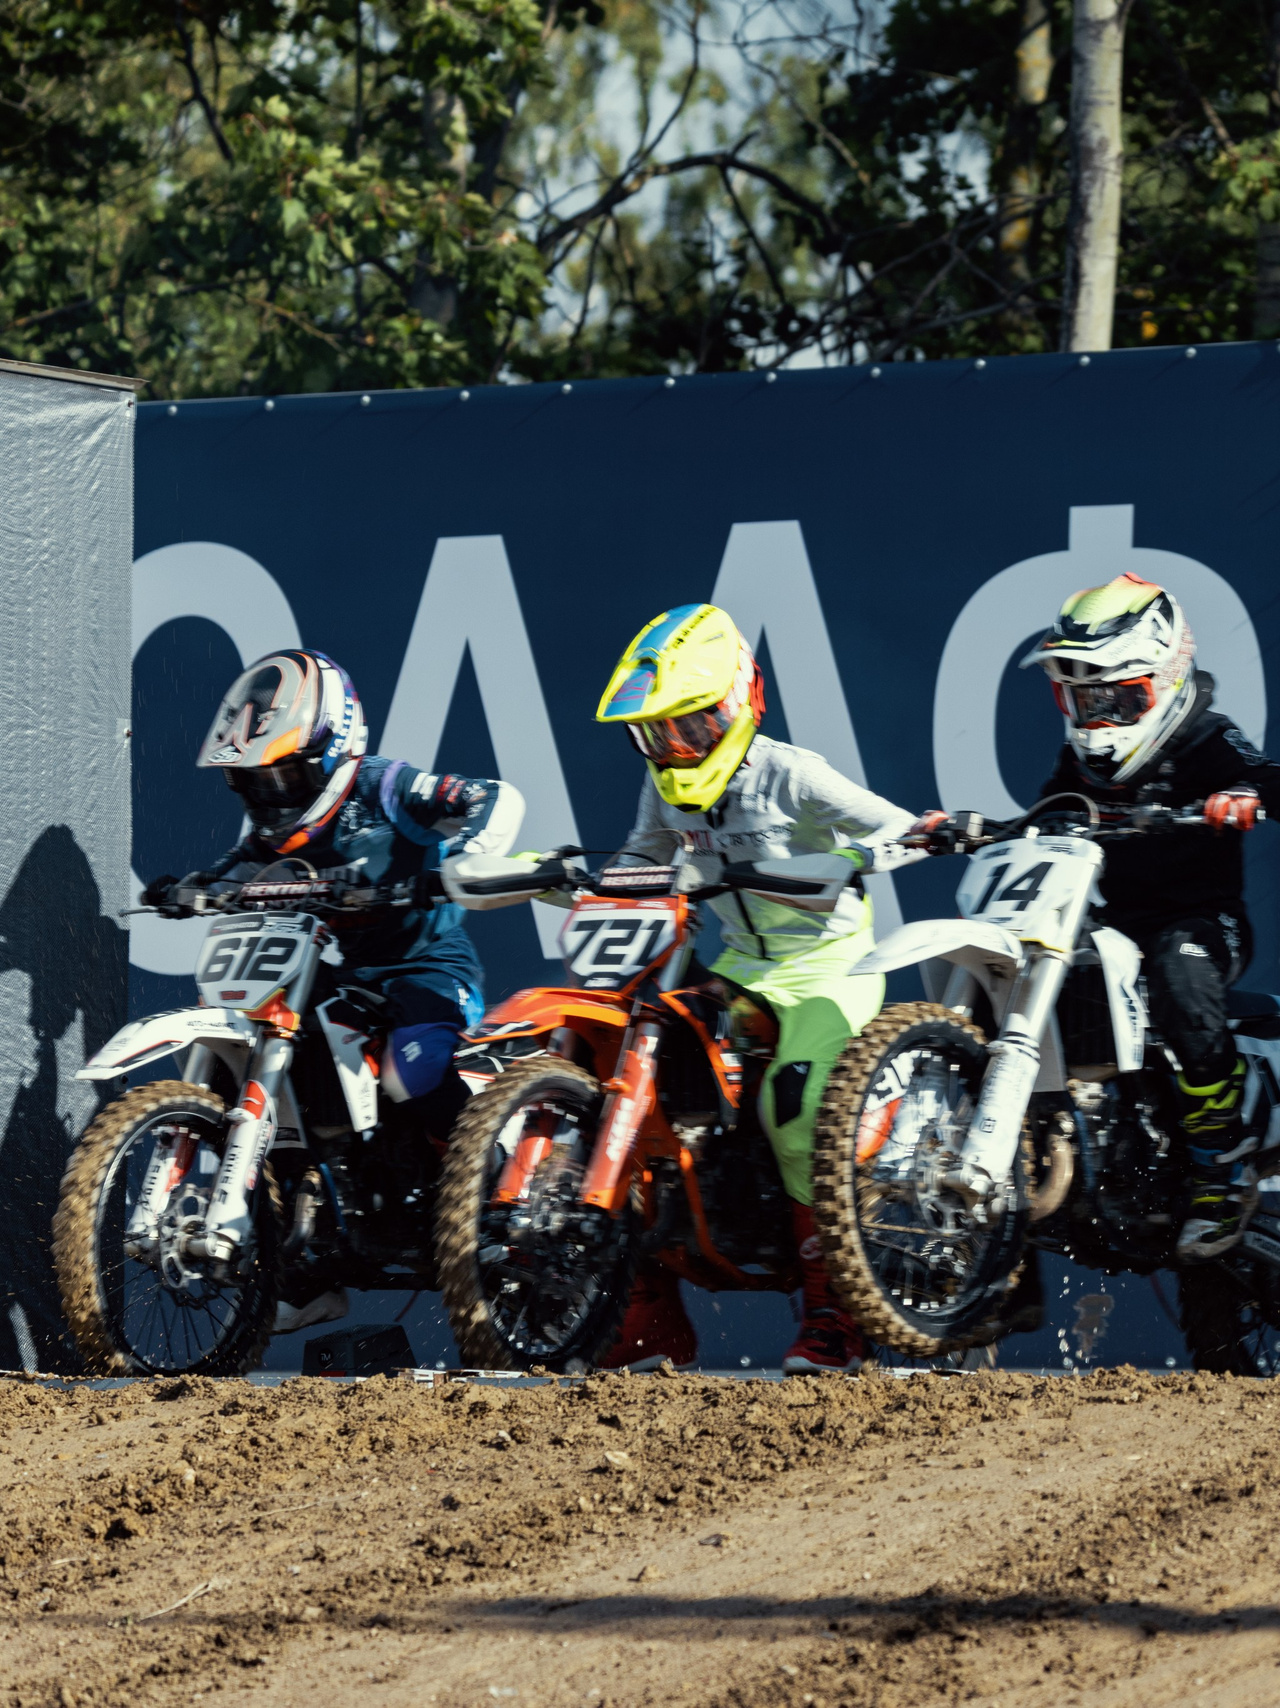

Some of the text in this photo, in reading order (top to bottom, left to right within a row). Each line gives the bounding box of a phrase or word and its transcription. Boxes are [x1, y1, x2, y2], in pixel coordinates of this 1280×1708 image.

[970, 861, 1054, 915] 14
[201, 937, 298, 984] 612
[570, 919, 667, 968] 721
